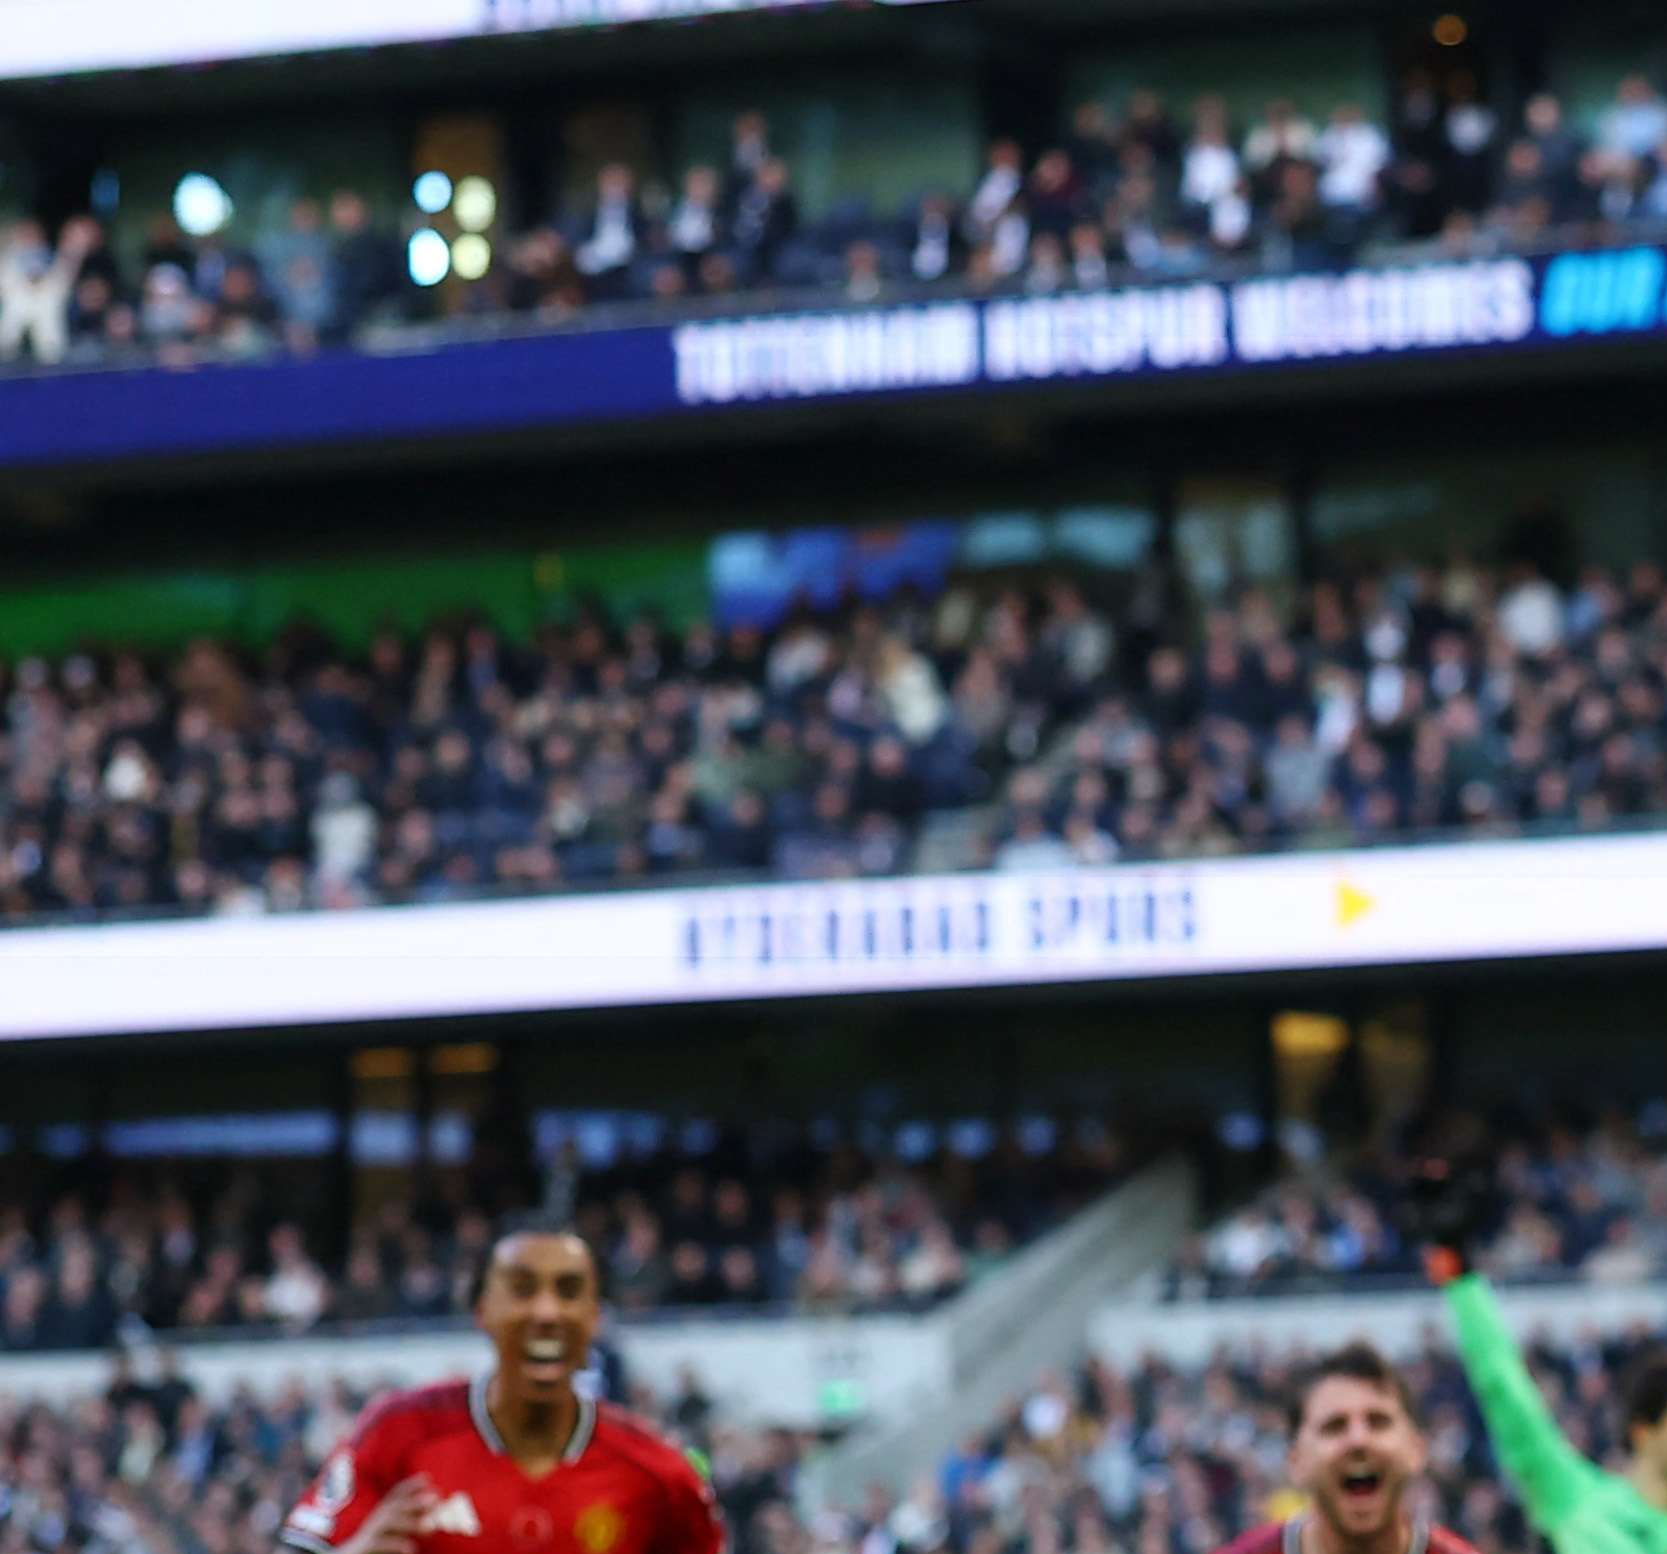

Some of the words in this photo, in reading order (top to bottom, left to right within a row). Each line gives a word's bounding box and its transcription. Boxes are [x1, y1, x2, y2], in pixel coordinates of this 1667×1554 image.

[673, 303, 979, 402] TOTTENHAM
[984, 284, 1226, 379] HOTSPUR
[1231, 259, 1534, 362] WELCOMES
[1540, 247, 1665, 337] OUR
[1026, 888, 1198, 953] SPURS
